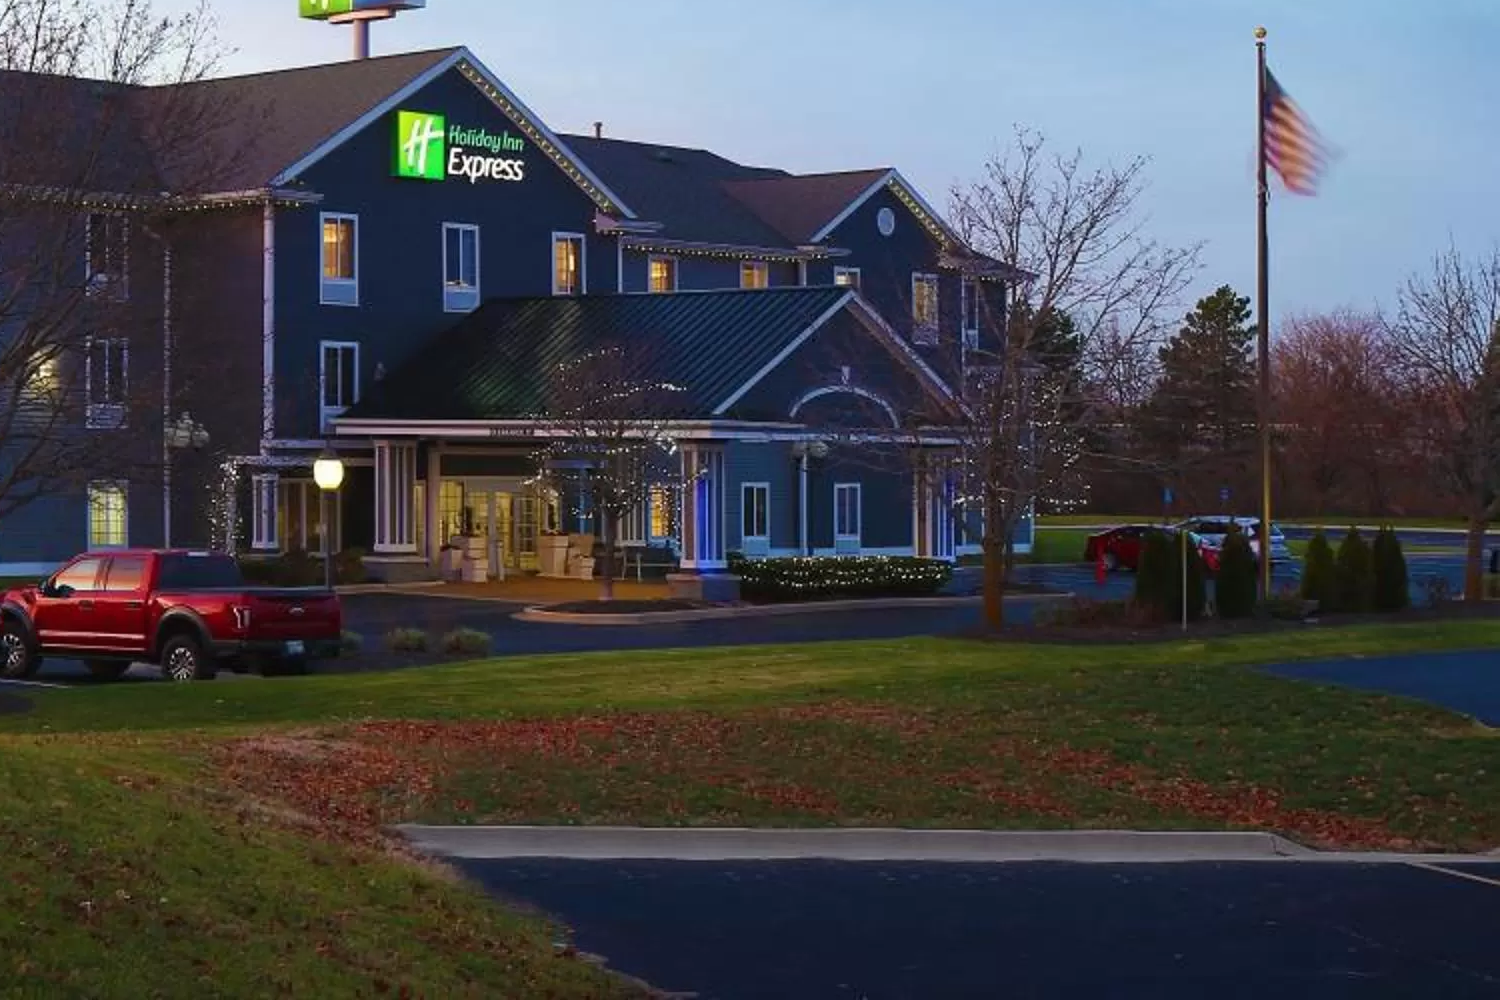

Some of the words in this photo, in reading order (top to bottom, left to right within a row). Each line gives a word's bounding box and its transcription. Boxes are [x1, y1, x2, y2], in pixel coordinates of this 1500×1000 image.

[449, 125, 501, 153] Holiday
[502, 130, 524, 152] Inn
[448, 147, 525, 184] Express
